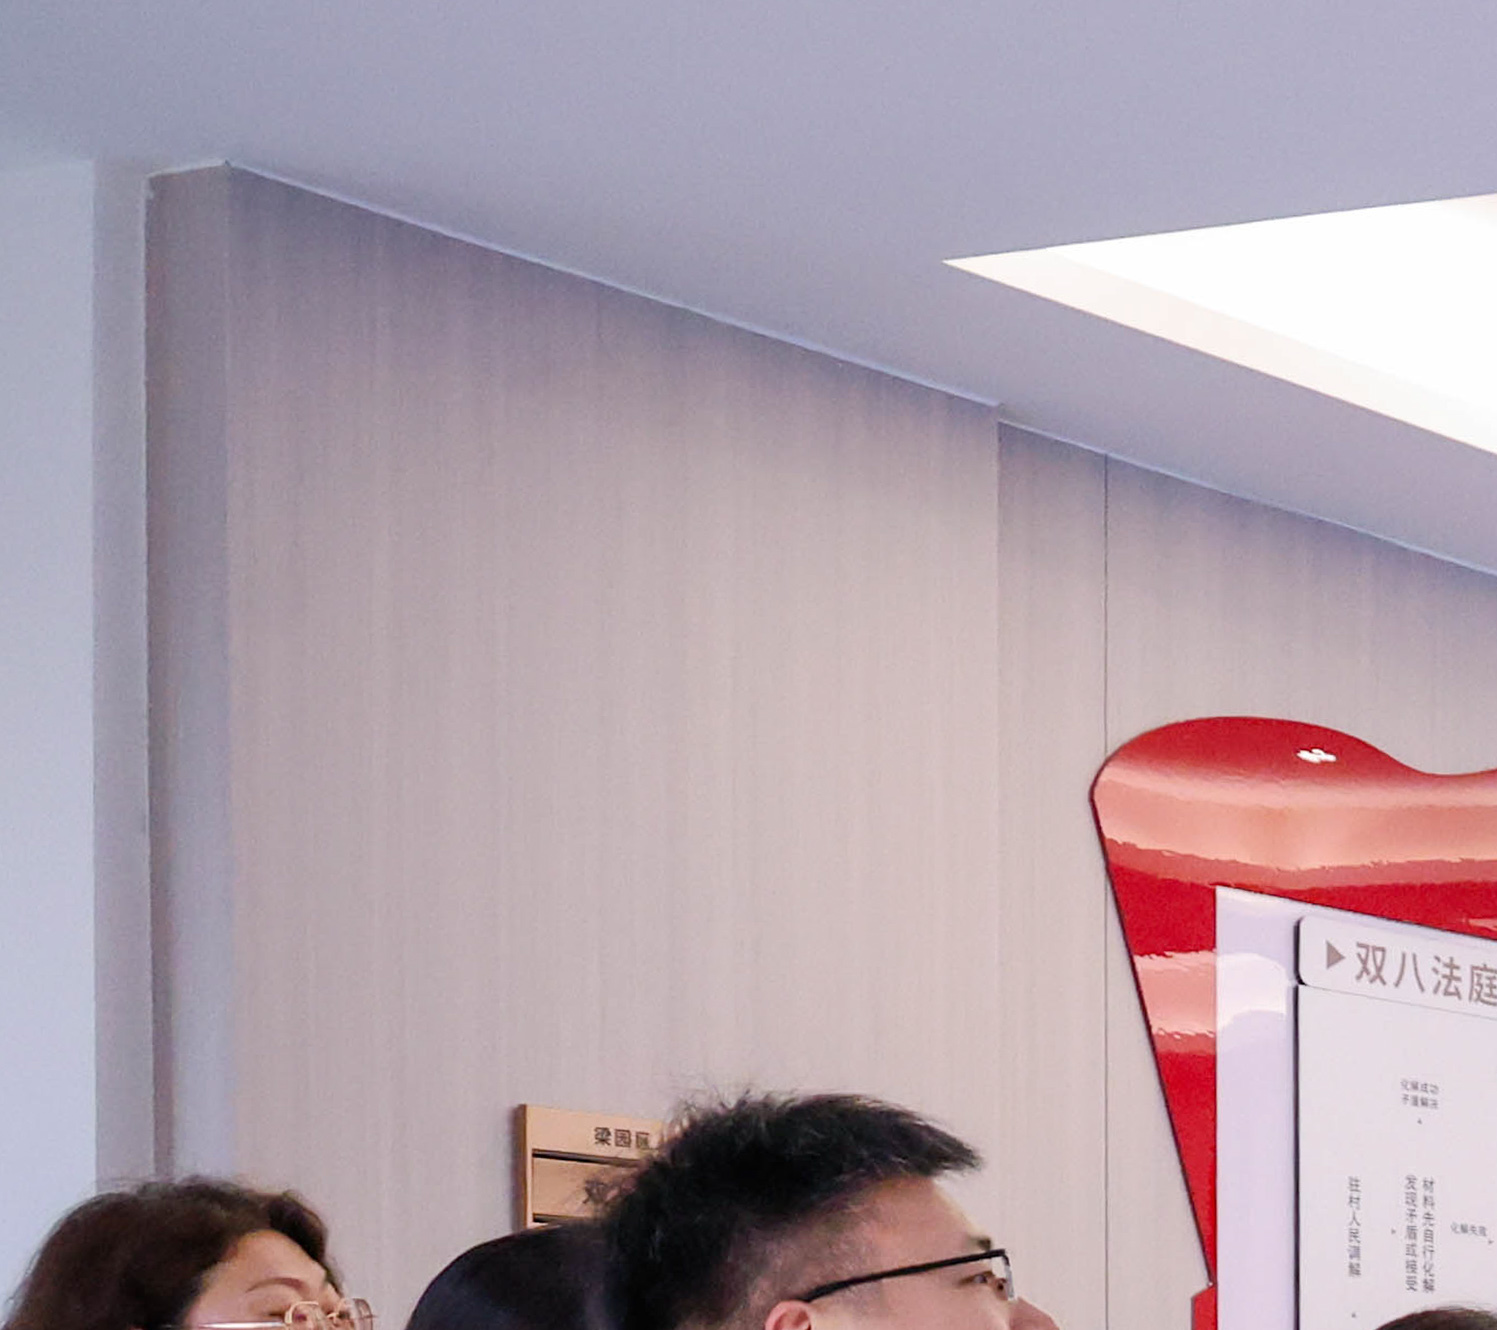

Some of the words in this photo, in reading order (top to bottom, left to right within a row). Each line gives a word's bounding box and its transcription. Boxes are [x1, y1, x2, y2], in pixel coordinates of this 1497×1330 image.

[1401, 1078, 1440, 1096] 化解成功
[1348, 1176, 1361, 1278] 驻村人民调解
[1405, 1175, 1418, 1292] 发现矛盾或接受
